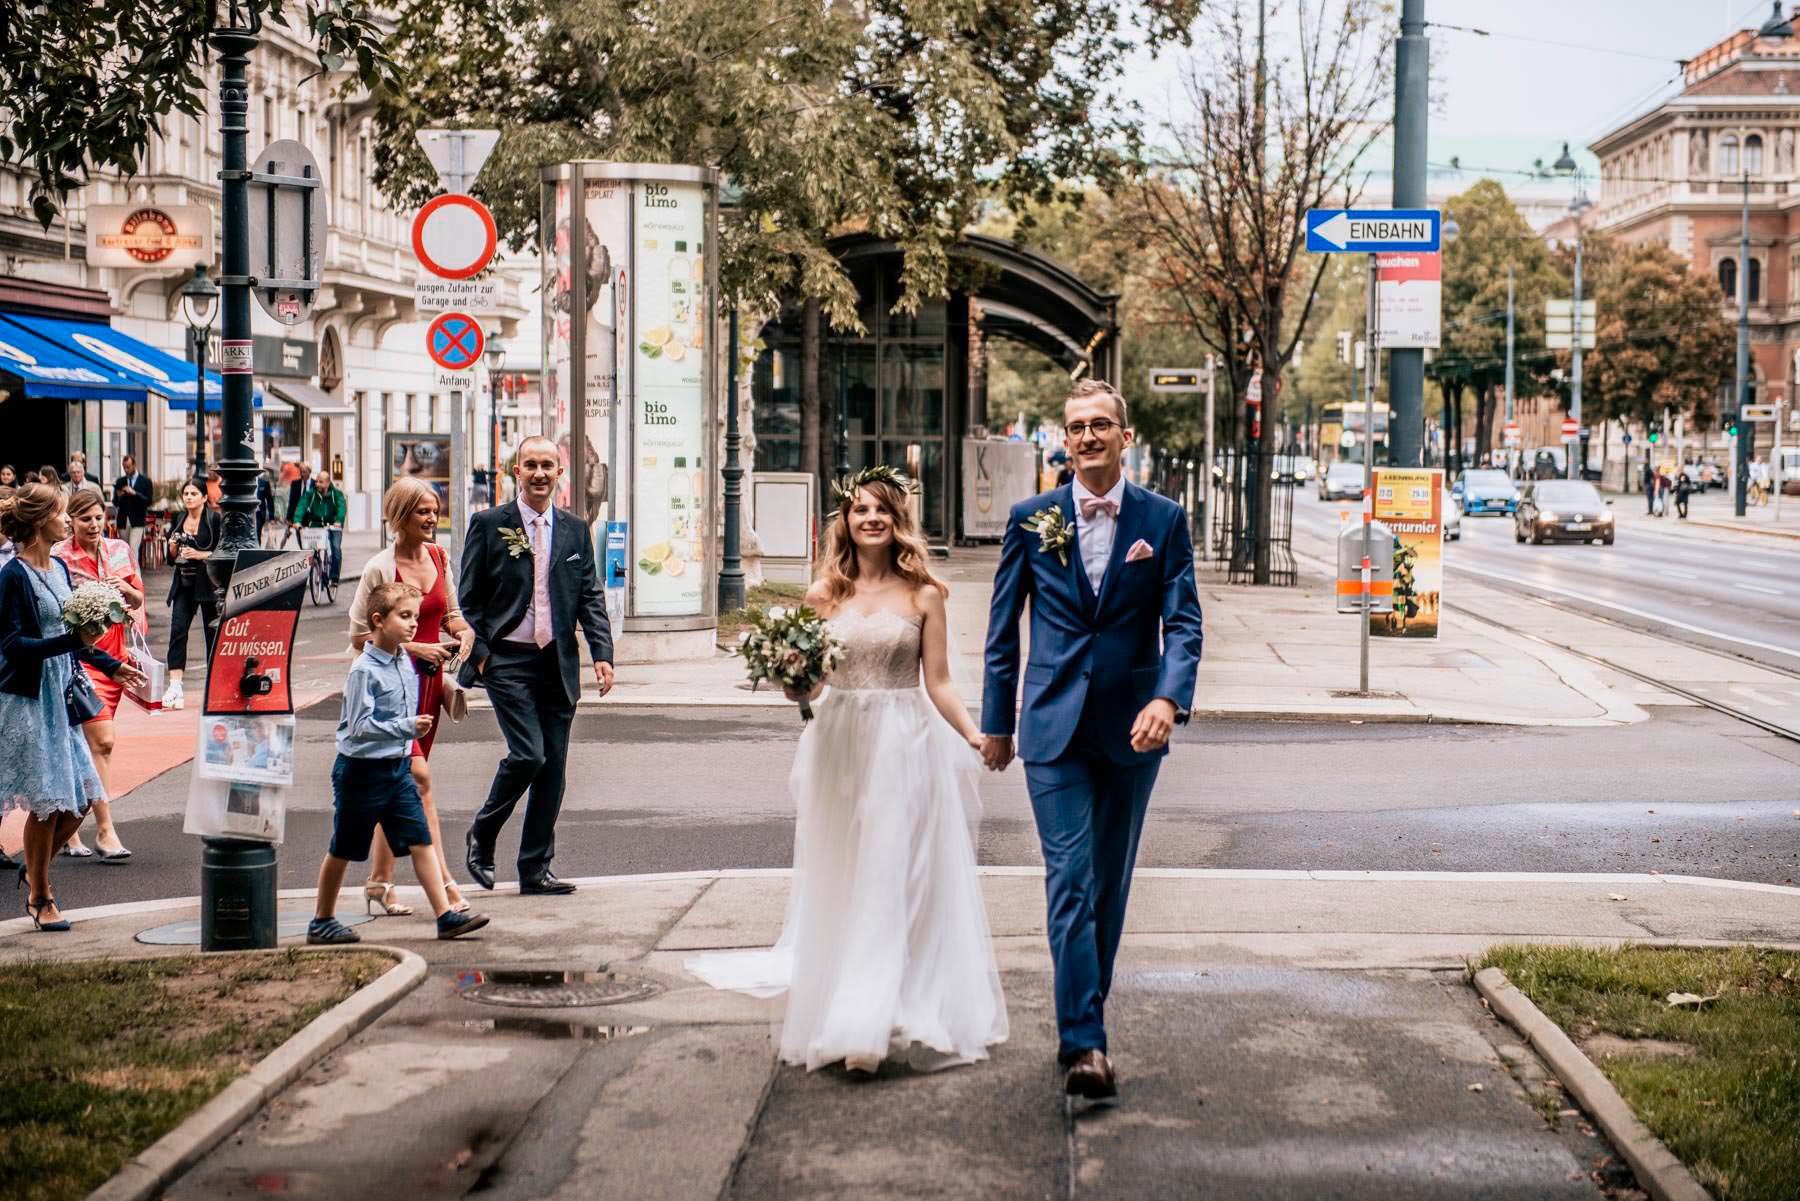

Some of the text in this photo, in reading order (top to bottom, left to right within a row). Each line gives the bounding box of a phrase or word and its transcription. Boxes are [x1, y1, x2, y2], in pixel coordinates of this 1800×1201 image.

[645, 183, 668, 196] bio
[645, 195, 677, 208] limo
[1350, 222, 1424, 239] EINBAHN
[447, 283, 477, 293] Zufahrt
[480, 286, 494, 294] zur
[421, 296, 467, 308] Garage und
[644, 401, 668, 413] bio
[644, 413, 677, 425] limo
[976, 446, 989, 480] K
[232, 558, 308, 599] WIENER ZEITUNG
[224, 617, 250, 637] Gut
[220, 640, 286, 656] zu wissen.
